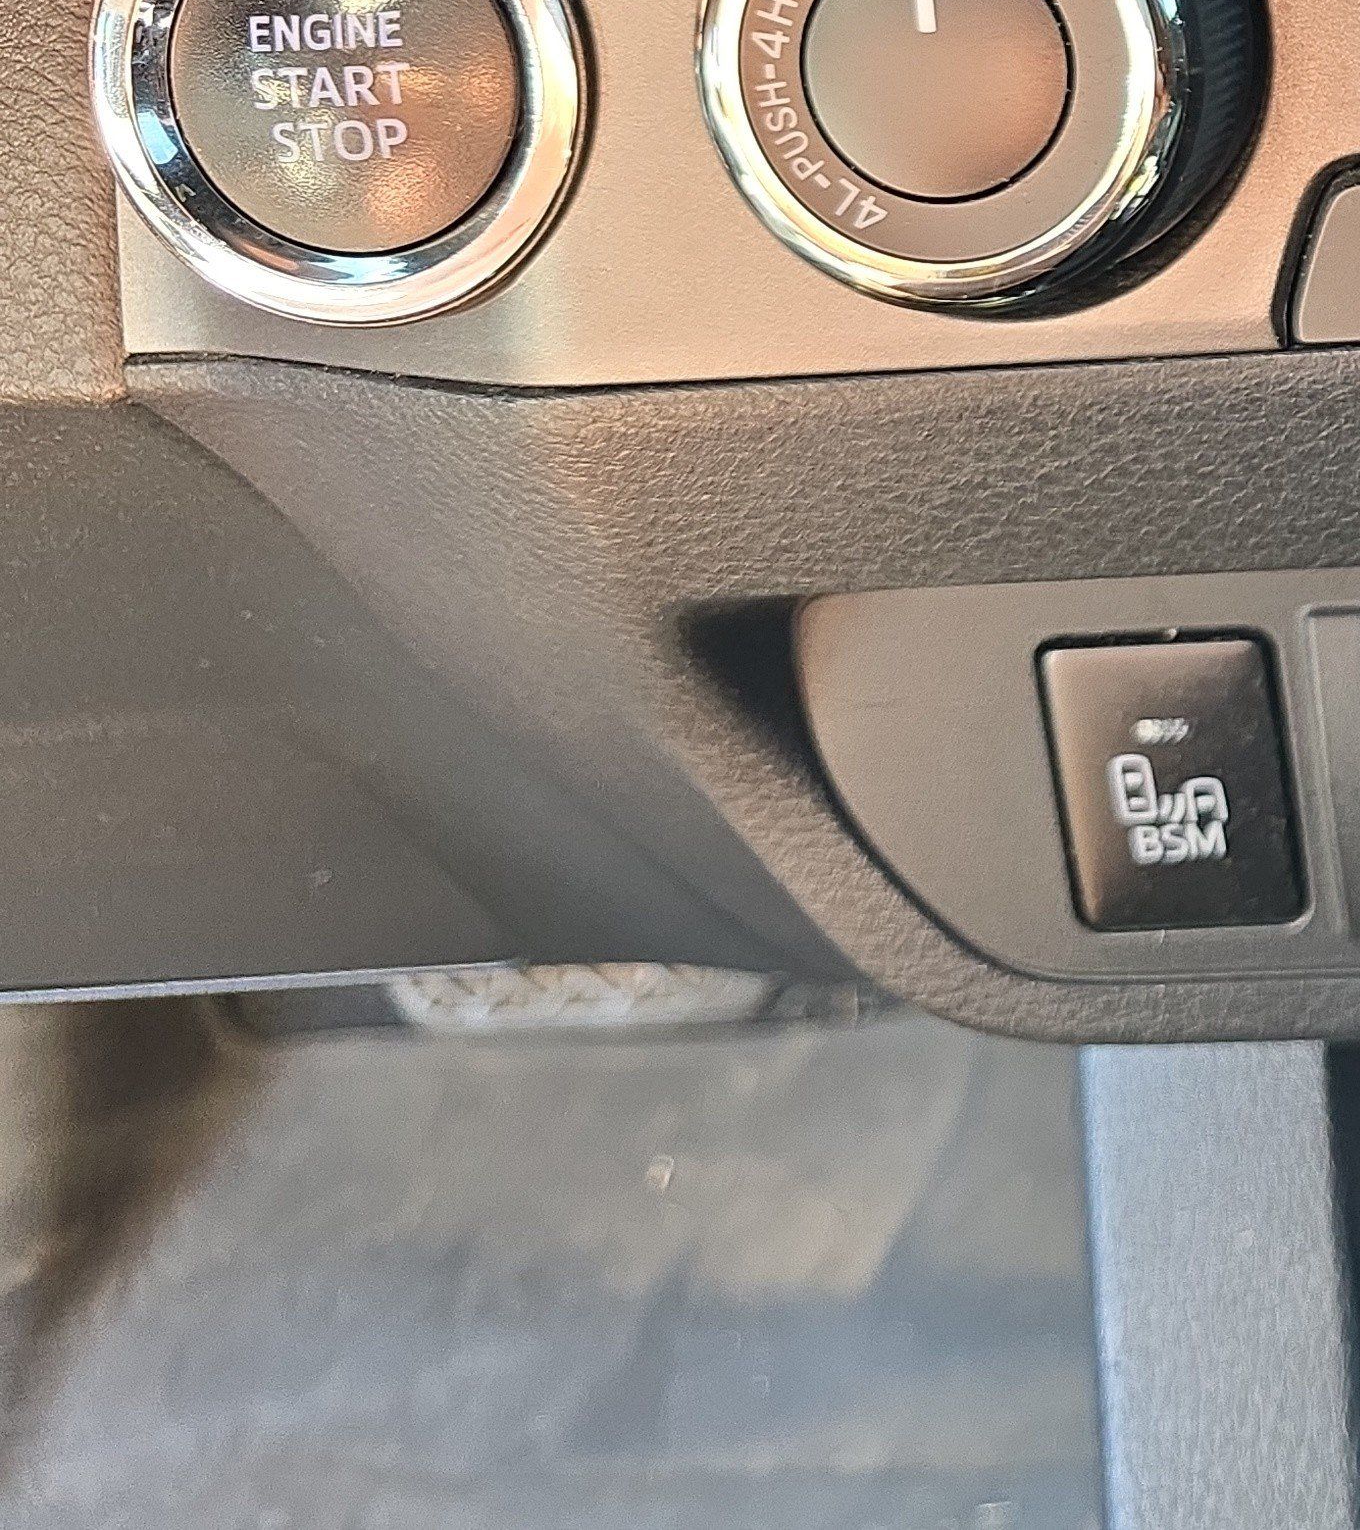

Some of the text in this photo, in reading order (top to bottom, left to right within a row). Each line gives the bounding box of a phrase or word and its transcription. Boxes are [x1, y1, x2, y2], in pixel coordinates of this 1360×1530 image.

[248, 10, 404, 53] ENGINE
[251, 62, 411, 110] START
[270, 118, 409, 164] STOP
[1128, 821, 1228, 865] BSM
